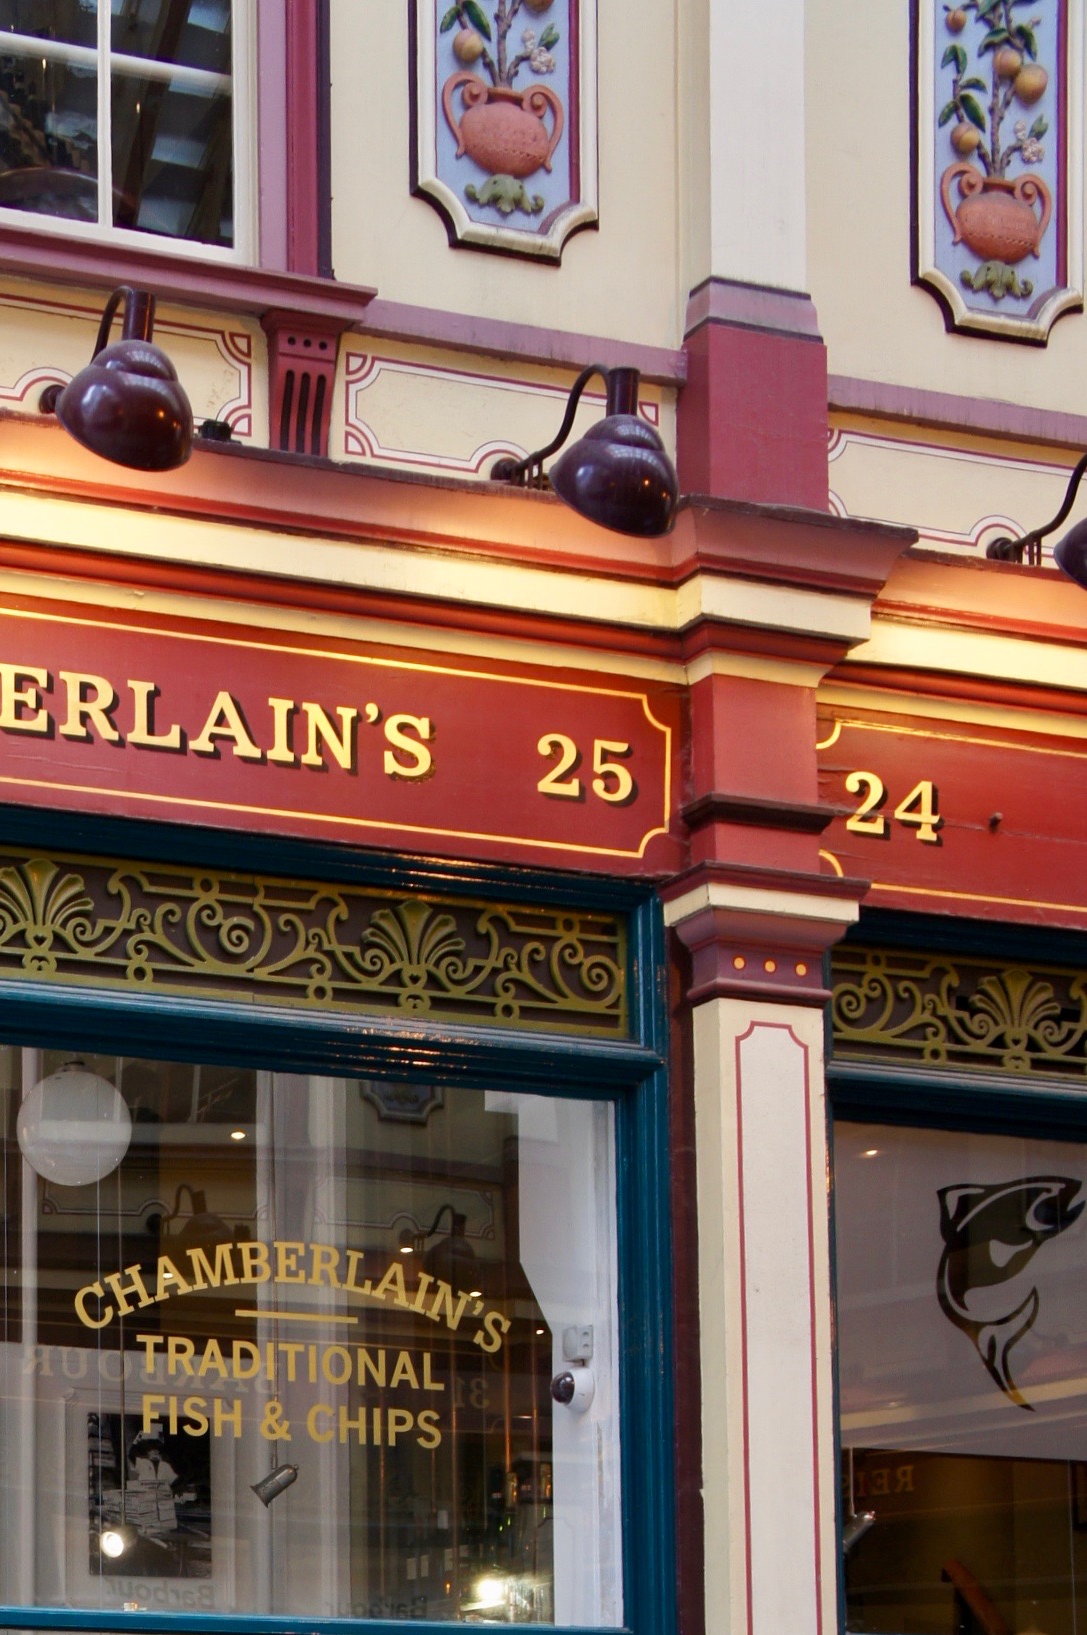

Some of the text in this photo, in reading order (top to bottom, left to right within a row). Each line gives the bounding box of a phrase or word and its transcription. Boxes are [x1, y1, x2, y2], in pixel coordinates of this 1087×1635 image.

[537, 732, 634, 803] 25
[845, 770, 941, 842] 24
[74, 1240, 511, 1354] CHAMBERLAIN'S
[135, 1334, 444, 1391] TRADITIONAL
[142, 1395, 442, 1450] FISH & CHIPS
